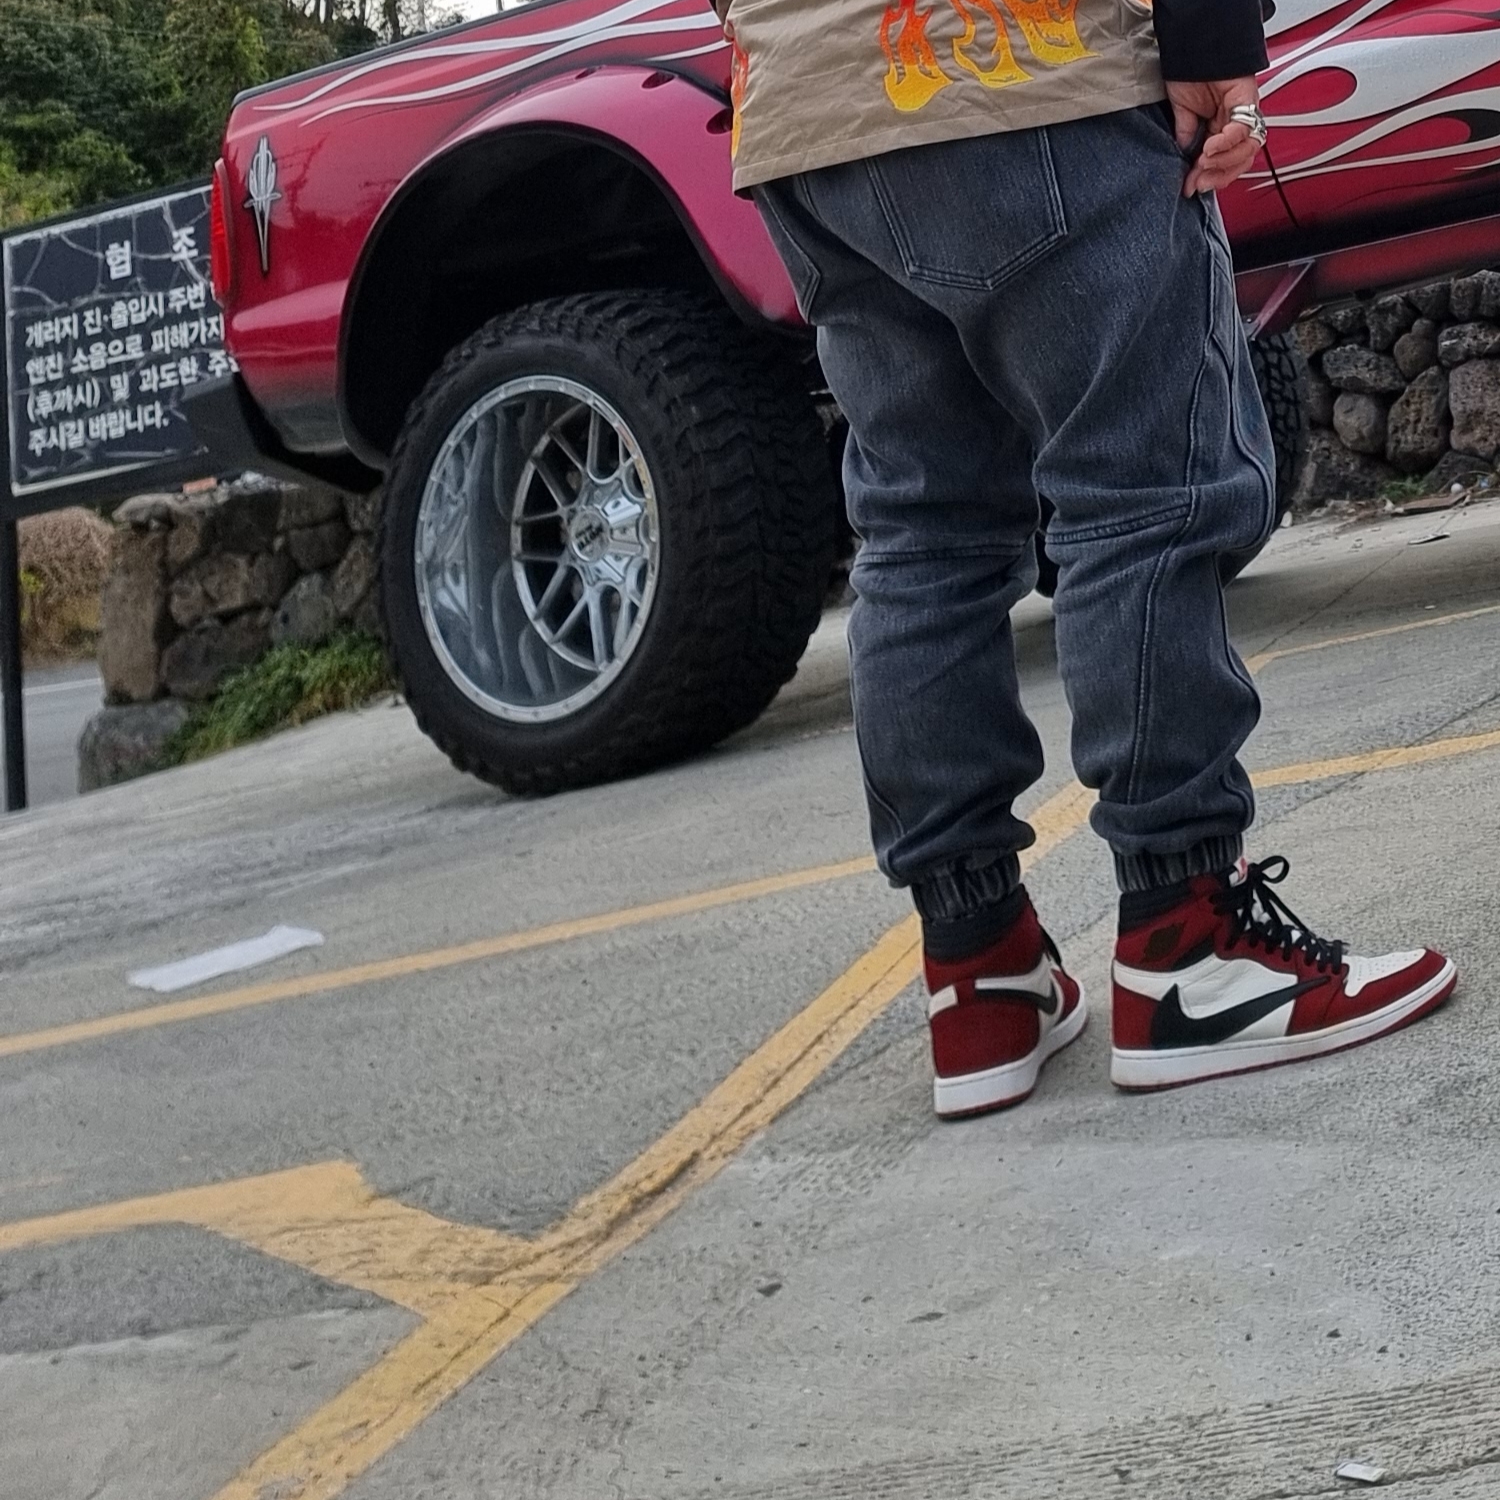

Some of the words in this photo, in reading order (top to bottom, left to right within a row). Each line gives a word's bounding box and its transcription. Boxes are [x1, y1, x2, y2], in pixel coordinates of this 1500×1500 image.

[105, 240, 132, 280] 협
[171, 226, 199, 262] 조
[168, 281, 206, 314] 주변
[26, 351, 64, 386] 엔진
[70, 333, 145, 374] 소음으로
[151, 312, 225, 355] 피해가지
[138, 355, 198, 393] 과도한
[28, 418, 85, 457] 주시길
[88, 400, 169, 442] 바랍니다.
